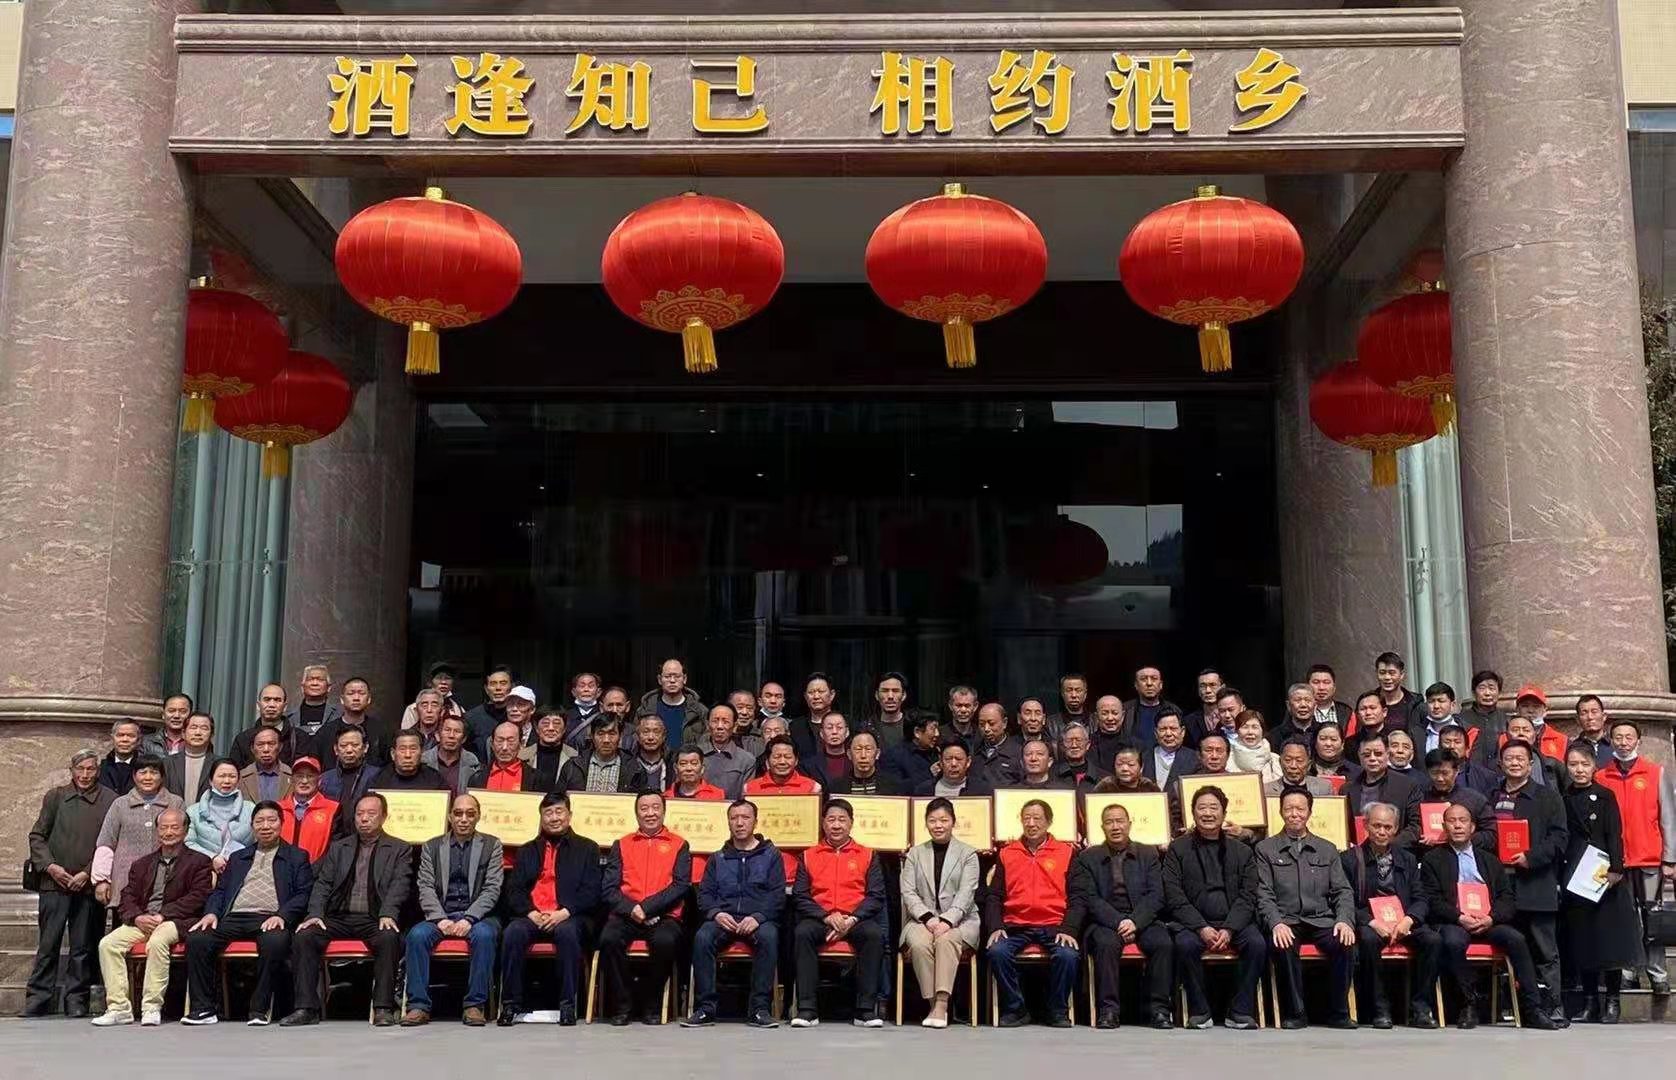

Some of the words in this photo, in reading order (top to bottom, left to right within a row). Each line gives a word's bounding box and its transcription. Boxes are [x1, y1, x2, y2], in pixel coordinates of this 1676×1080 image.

[328, 53, 769, 137] 酒逢知己
[872, 48, 1308, 134] 相约酒乡
